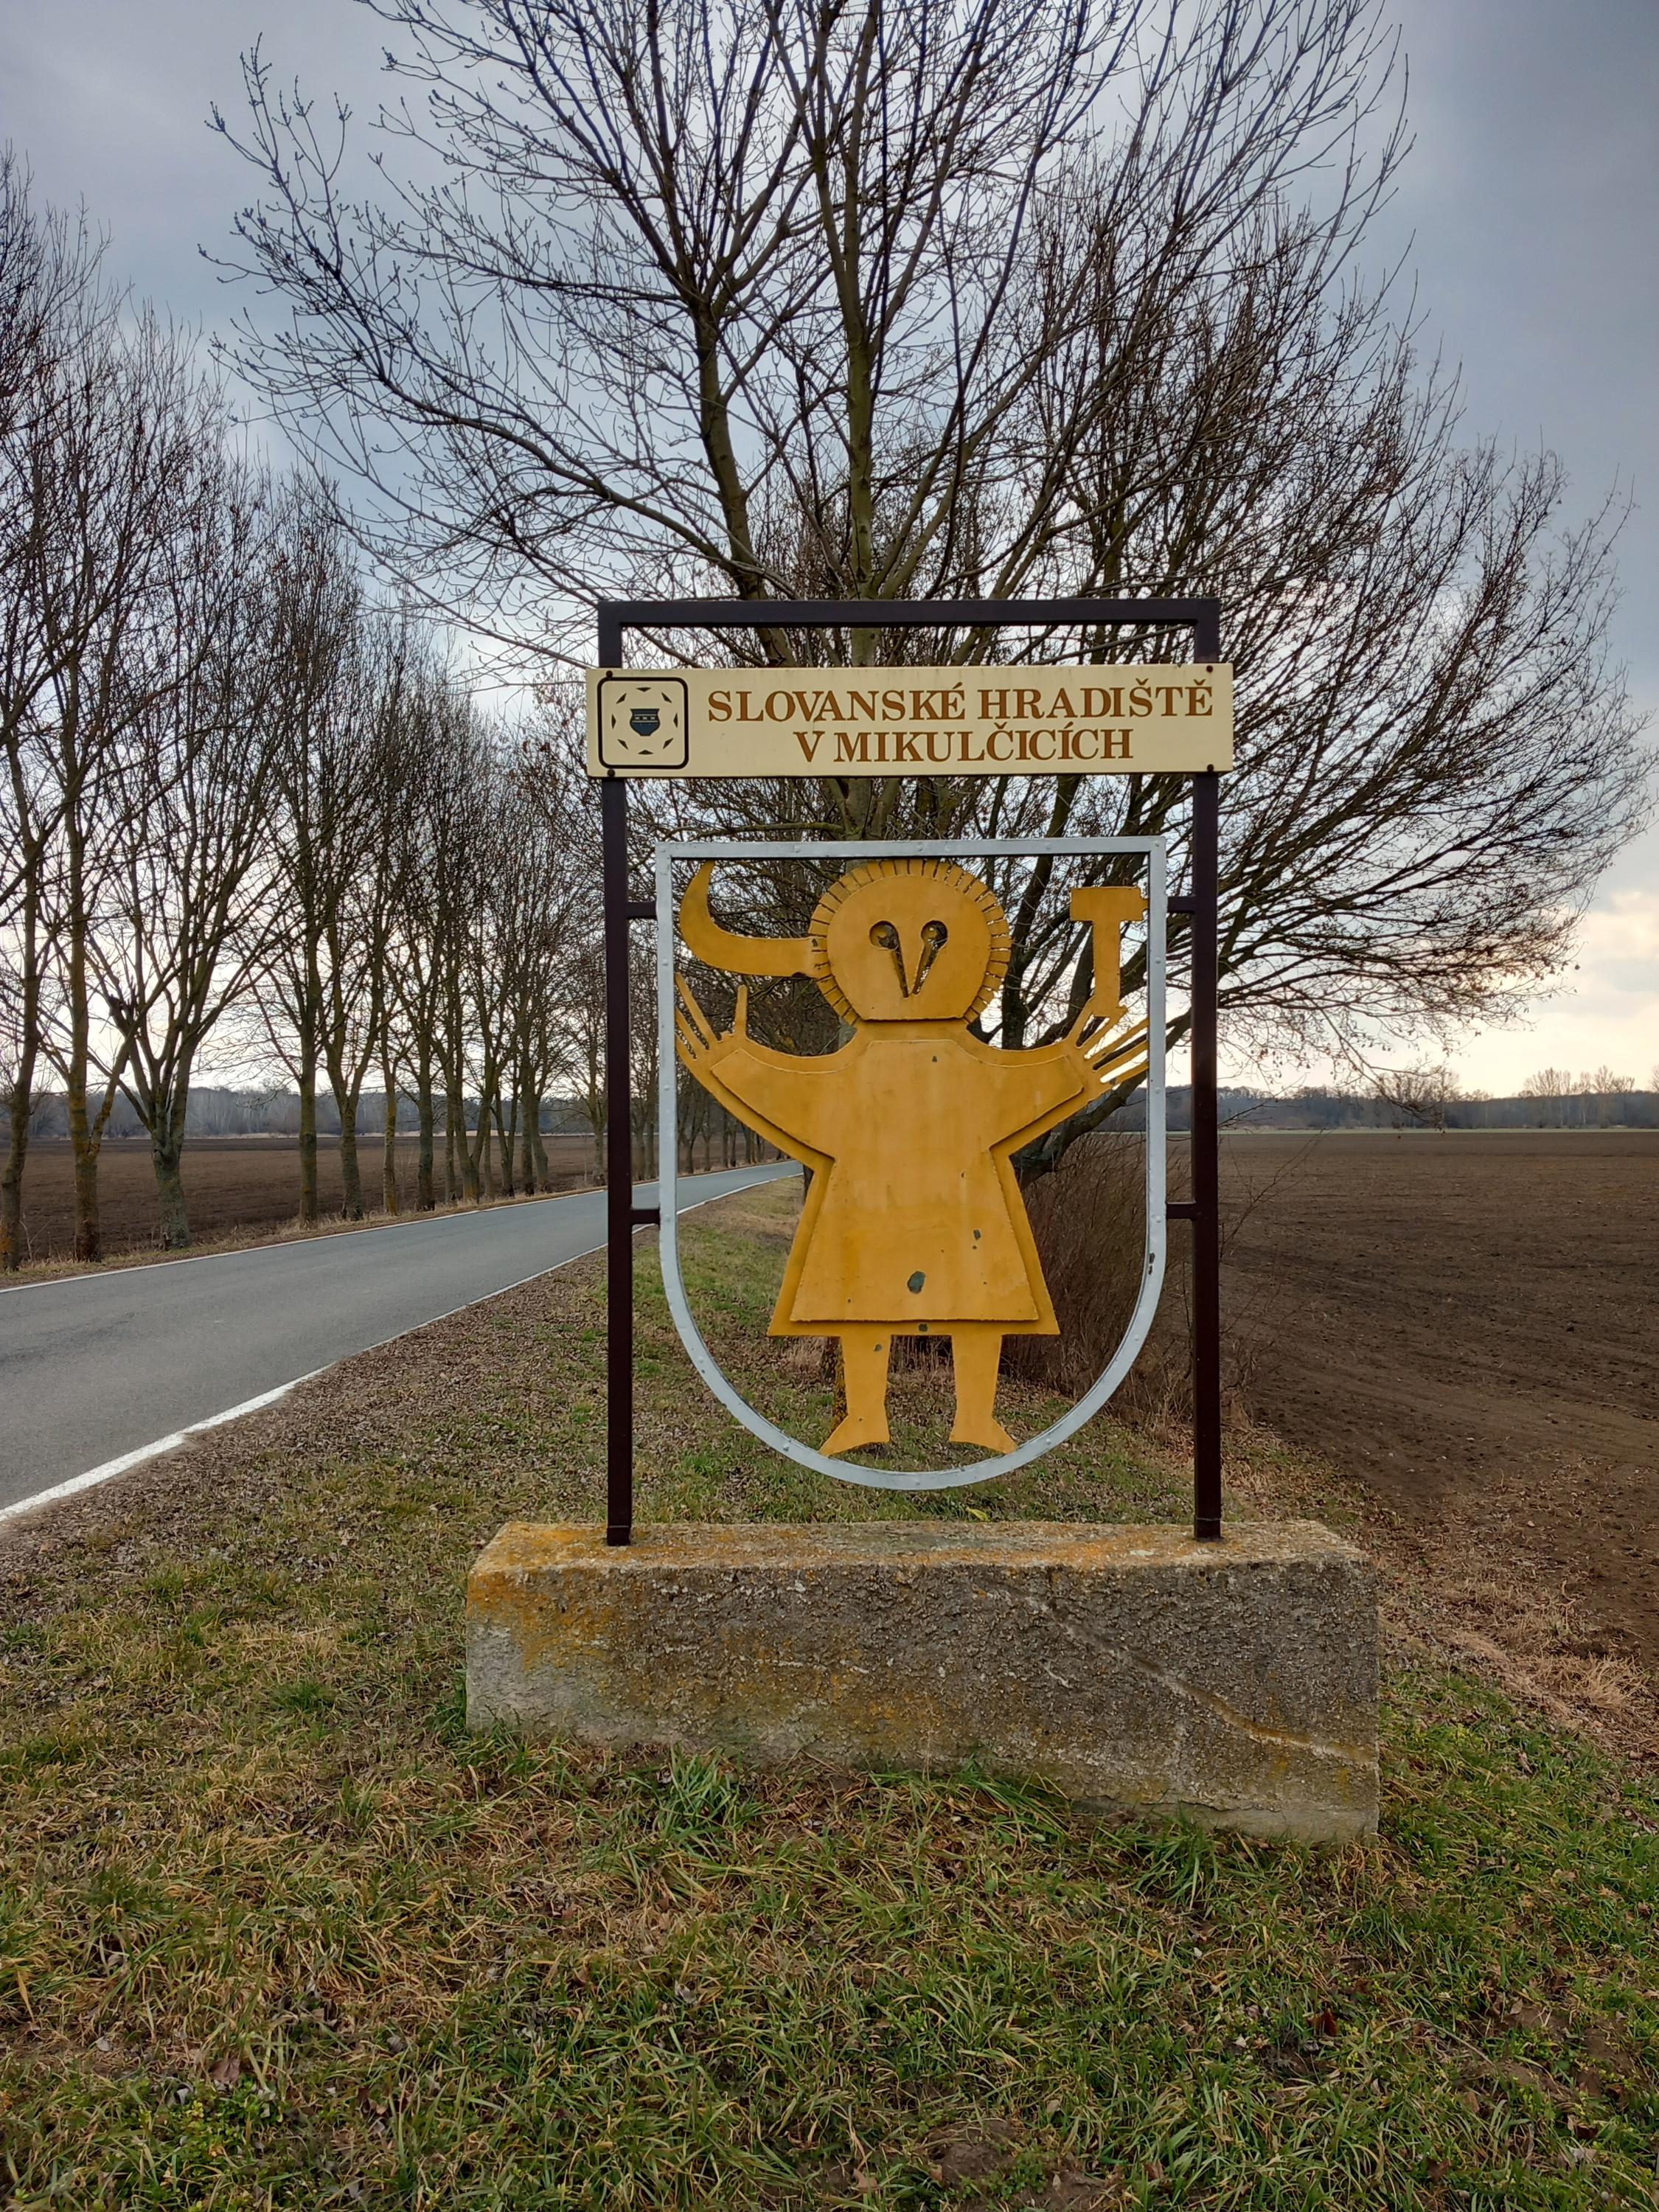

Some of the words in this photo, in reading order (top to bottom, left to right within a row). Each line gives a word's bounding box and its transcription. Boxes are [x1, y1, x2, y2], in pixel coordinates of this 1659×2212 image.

[707, 682, 966, 723] SLOVANSKÉ
[977, 678, 1214, 720] HRADIŠTĚ
[793, 730, 825, 763] V
[833, 721, 1134, 762] MIKULČICÍCH
